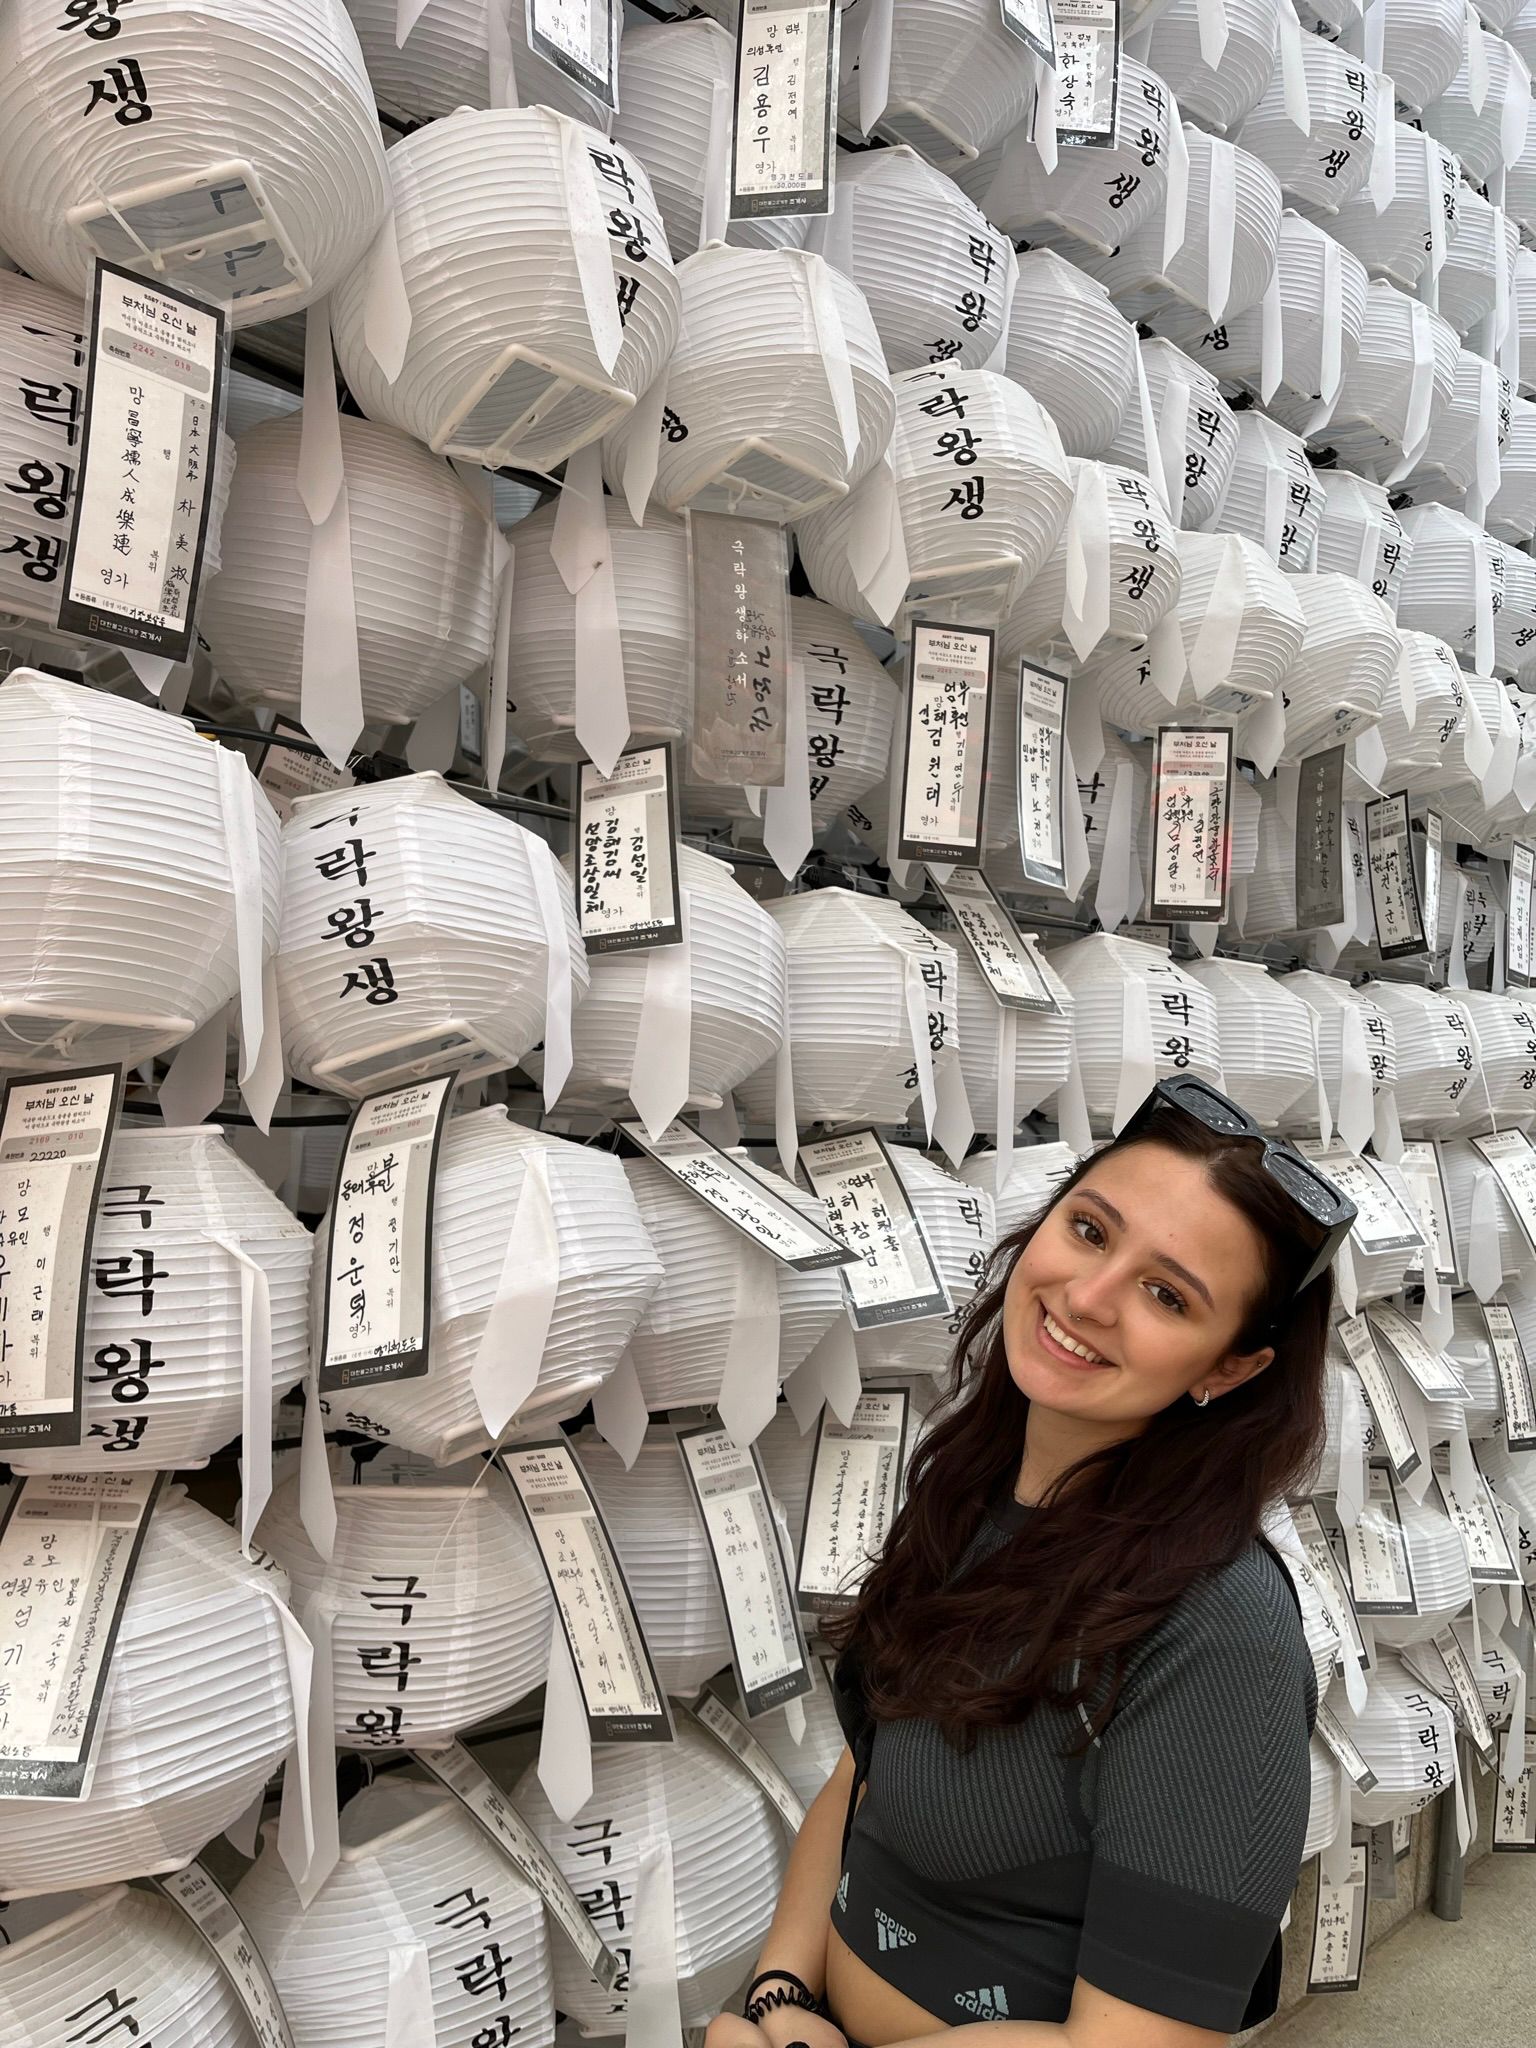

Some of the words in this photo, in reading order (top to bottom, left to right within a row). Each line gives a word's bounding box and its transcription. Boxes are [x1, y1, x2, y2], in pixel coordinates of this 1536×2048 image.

[766, 24, 778, 39] 망
[1319, 69, 1367, 179] 락왕생
[1105, 79, 1166, 209] 락왕생
[755, 160, 777, 175] 영가
[122, 295, 156, 319] 부처님
[160, 312, 182, 330] 오신
[186, 322, 198, 337] 날
[129, 386, 145, 406] 망
[1116, 477, 1160, 600] 락왕생
[100, 567, 129, 590] 영가
[731, 539, 749, 689] 극락왕생하소서
[25, 1097, 55, 1111] 부처님
[58, 1094, 81, 1107] 오신
[83, 1092, 94, 1105] 날
[373, 1100, 399, 1113] 부처님
[401, 1094, 419, 1106] 오신
[421, 1091, 431, 1100] 날
[30, 1149, 66, 1162] 22220
[18, 1179, 31, 1197] 망
[41, 1534, 57, 1550] 망
[874, 1907, 917, 1944] adidas
